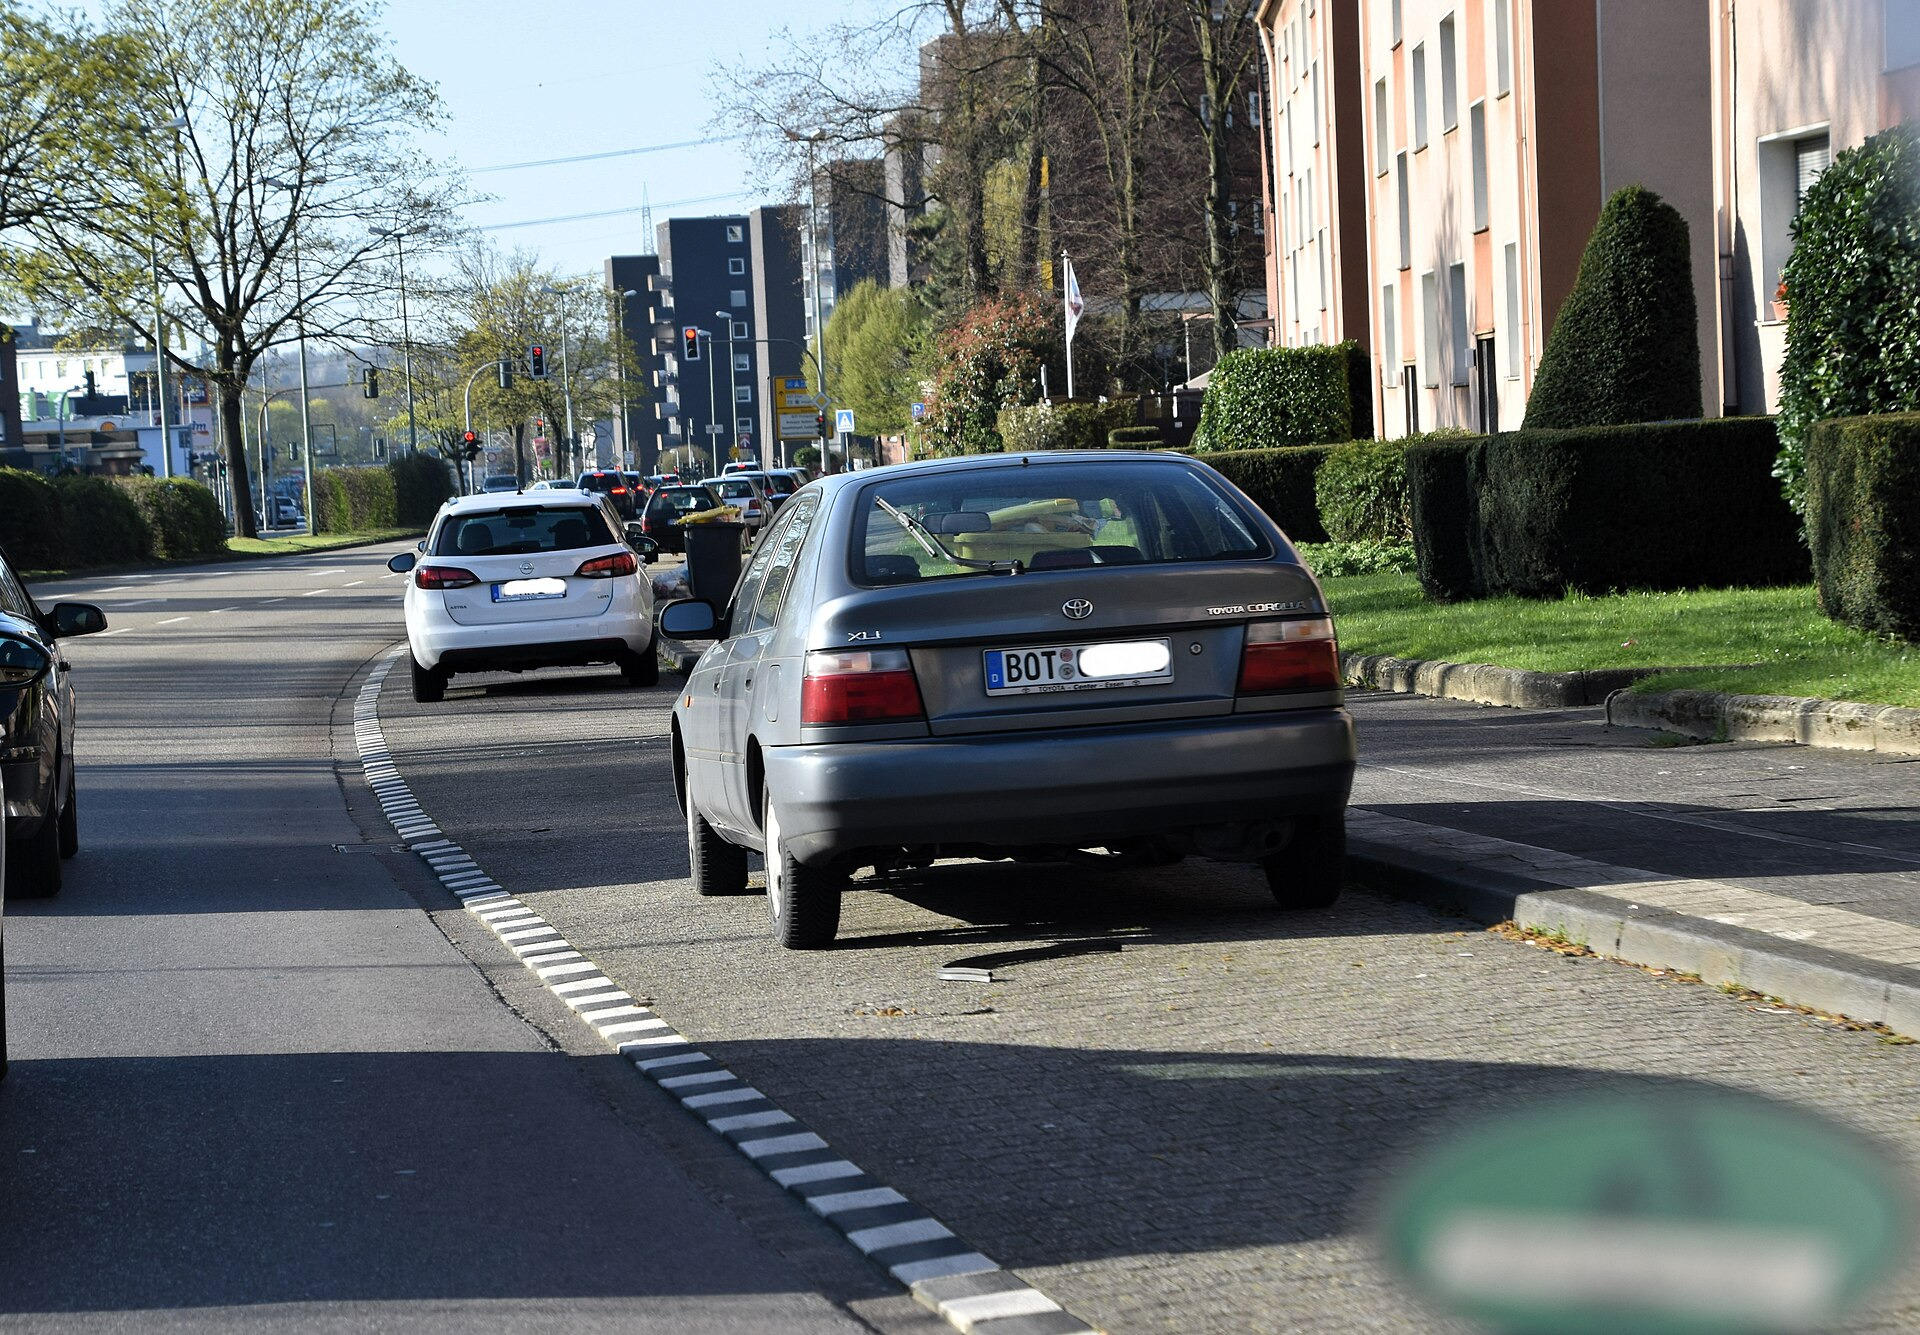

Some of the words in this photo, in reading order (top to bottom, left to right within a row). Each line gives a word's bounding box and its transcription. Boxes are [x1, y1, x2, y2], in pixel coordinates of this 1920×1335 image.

[1206, 605, 1244, 615] TOYOTA
[1247, 601, 1306, 612] COROLLA
[1006, 650, 1057, 683] BOT
